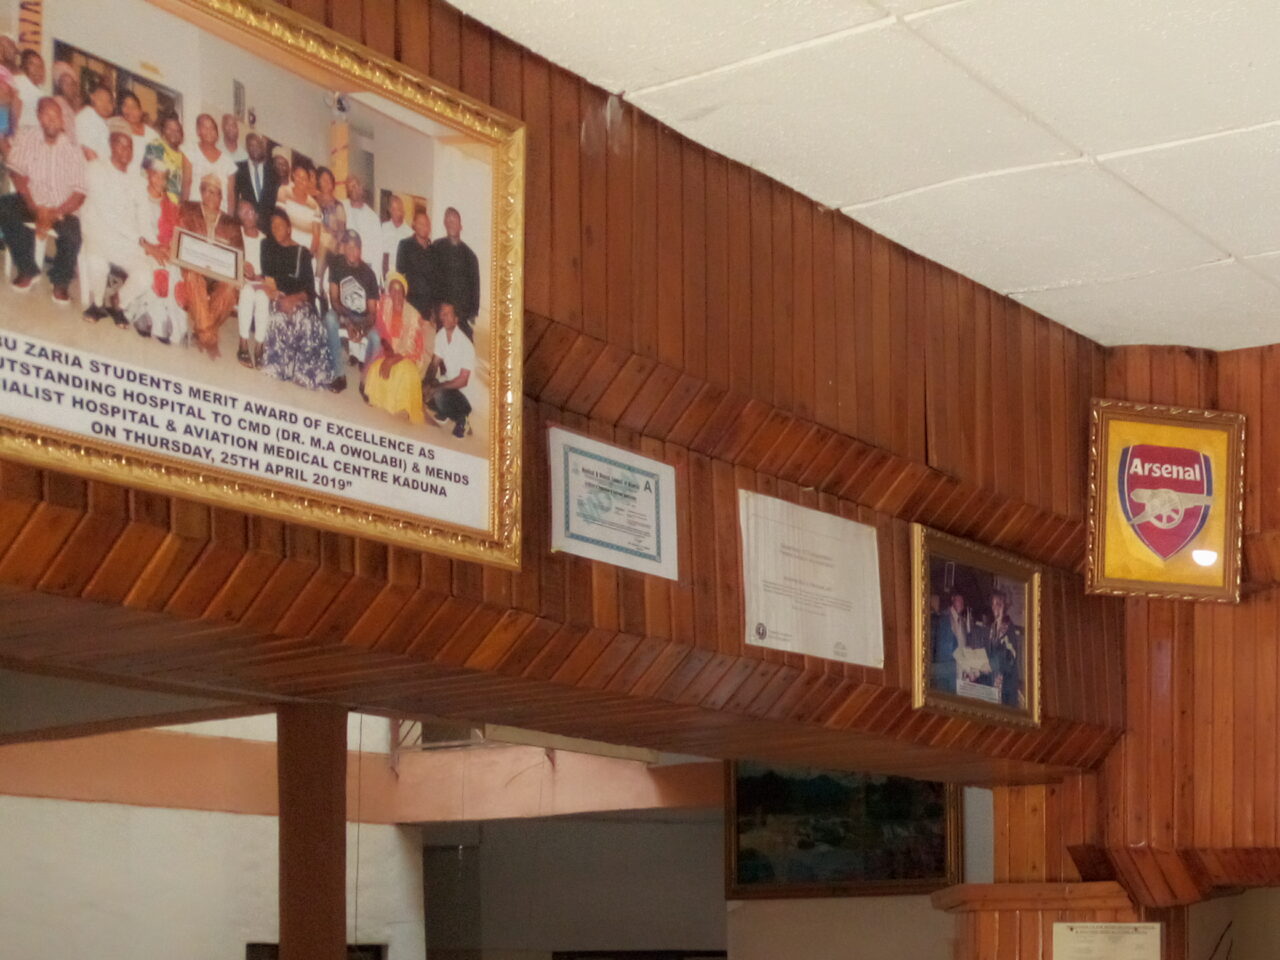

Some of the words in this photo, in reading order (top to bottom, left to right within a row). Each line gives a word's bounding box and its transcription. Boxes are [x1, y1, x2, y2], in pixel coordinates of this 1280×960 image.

[0, 337, 17, 351] U
[24, 342, 83, 369] ZARIA
[90, 360, 183, 395] STUDENTS
[189, 386, 238, 409] MERIT
[244, 401, 298, 424] AWARD
[303, 416, 322, 430] OF
[327, 422, 414, 456] EXCELLENCE
[419, 447, 435, 460] AS
[123, 386, 206, 421] HOSPITAL
[212, 411, 232, 427] TO
[238, 418, 271, 437] CMD
[276, 427, 305, 445] (DR.
[310, 436, 335, 453] M.A
[340, 444, 407, 472] OWOLABI)
[412, 463, 421, 474] &
[426, 466, 470, 486] MENDS
[72, 393, 159, 428] HOSPITAL
[166, 419, 177, 432] &
[184, 424, 258, 451] AVIATION
[264, 443, 328, 469] MEDICAL
[333, 460, 388, 483] CENTRE
[393, 475, 447, 497] KADUNA
[91, 421, 116, 437] ON
[123, 428, 215, 464] THURSDAY,
[220, 454, 260, 473] 25TH
[265, 462, 308, 482] APRIL
[1129, 458, 1201, 481] Arsenal
[643, 480, 652, 493] A
